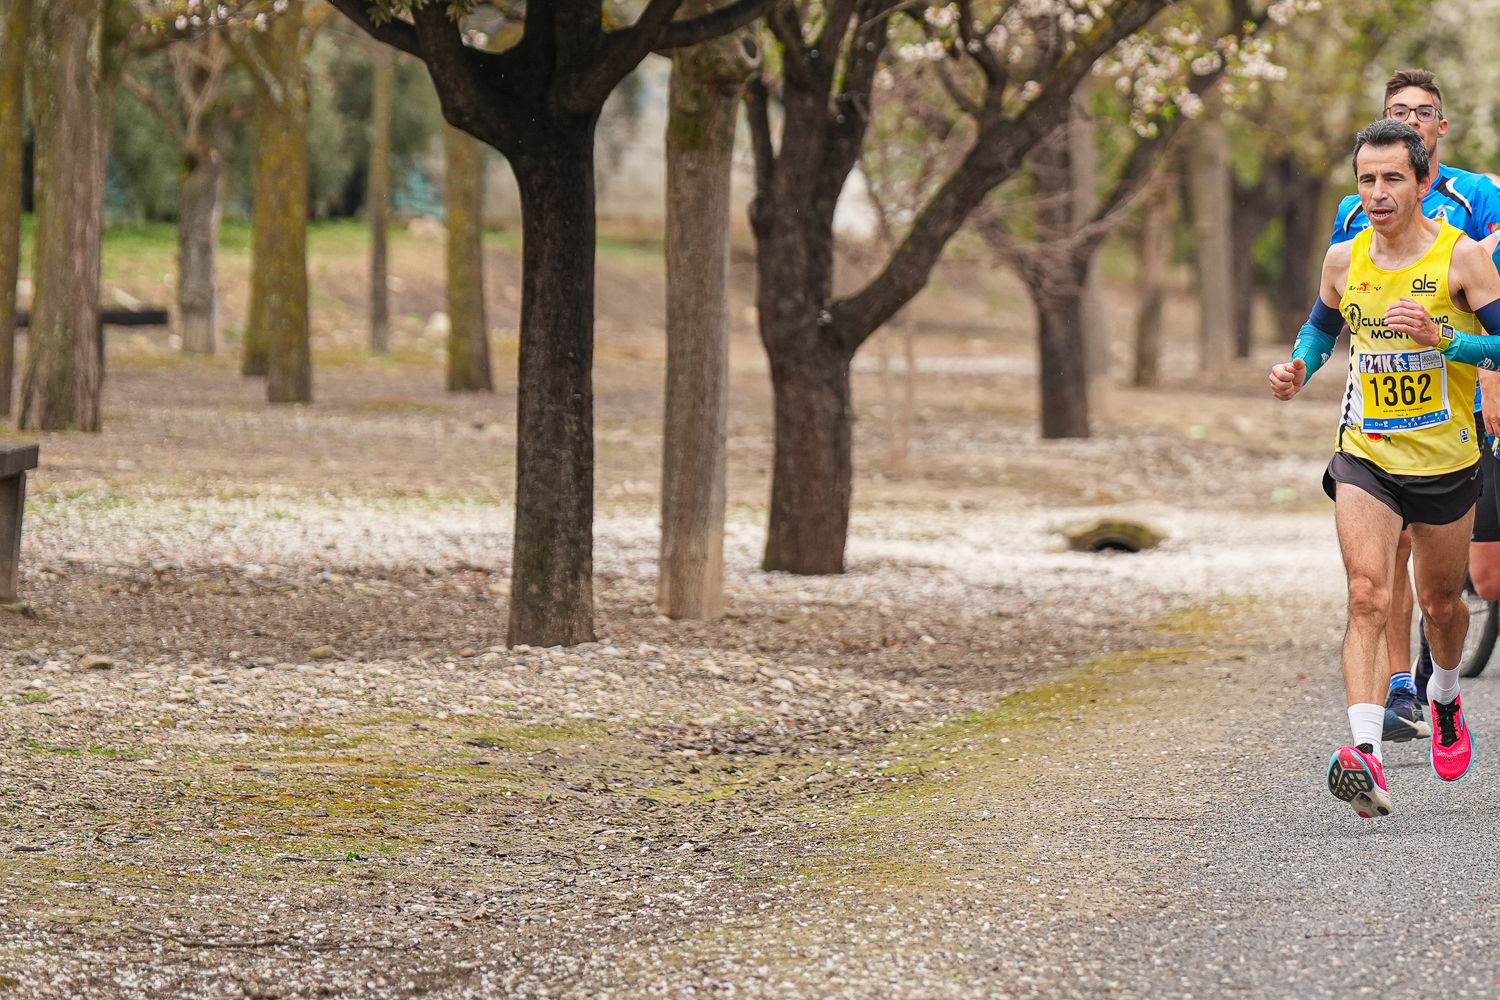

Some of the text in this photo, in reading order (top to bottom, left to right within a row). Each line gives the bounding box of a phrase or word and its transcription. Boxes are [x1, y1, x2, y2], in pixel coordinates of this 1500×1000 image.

[1411, 273, 1437, 293] als
[1365, 354, 1394, 373] 21K
[1369, 373, 1432, 407] 1362
